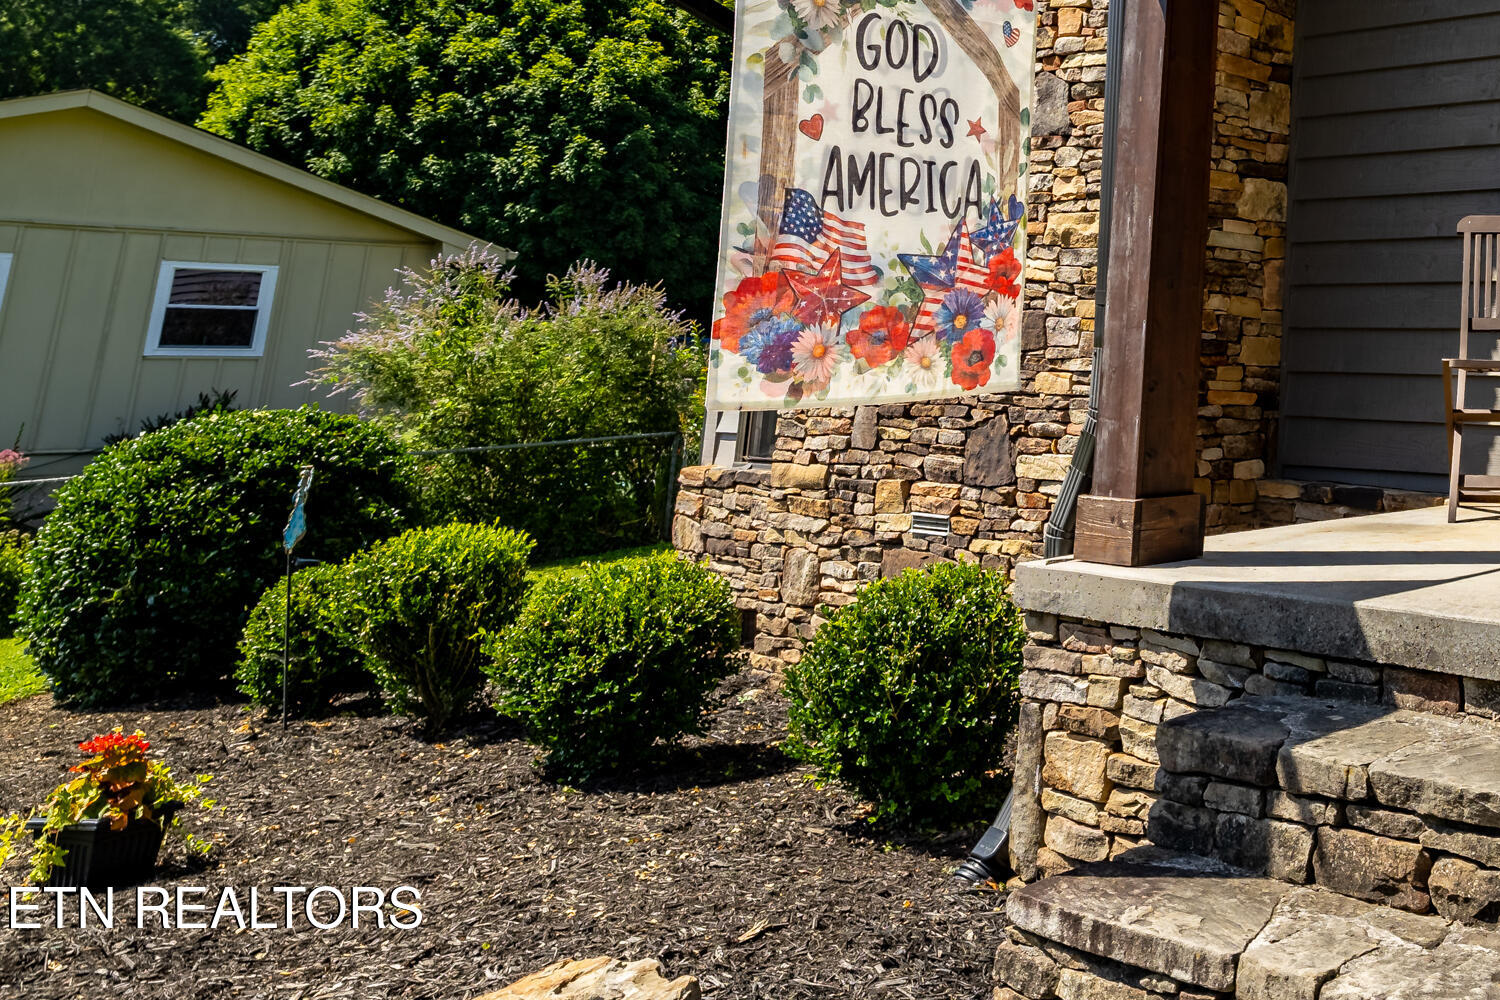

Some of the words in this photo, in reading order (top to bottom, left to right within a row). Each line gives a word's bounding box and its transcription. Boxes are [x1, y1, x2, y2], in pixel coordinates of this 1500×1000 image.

[855, 12, 939, 83] GOD
[852, 78, 960, 148] BLESS
[821, 145, 984, 219] AMERICA
